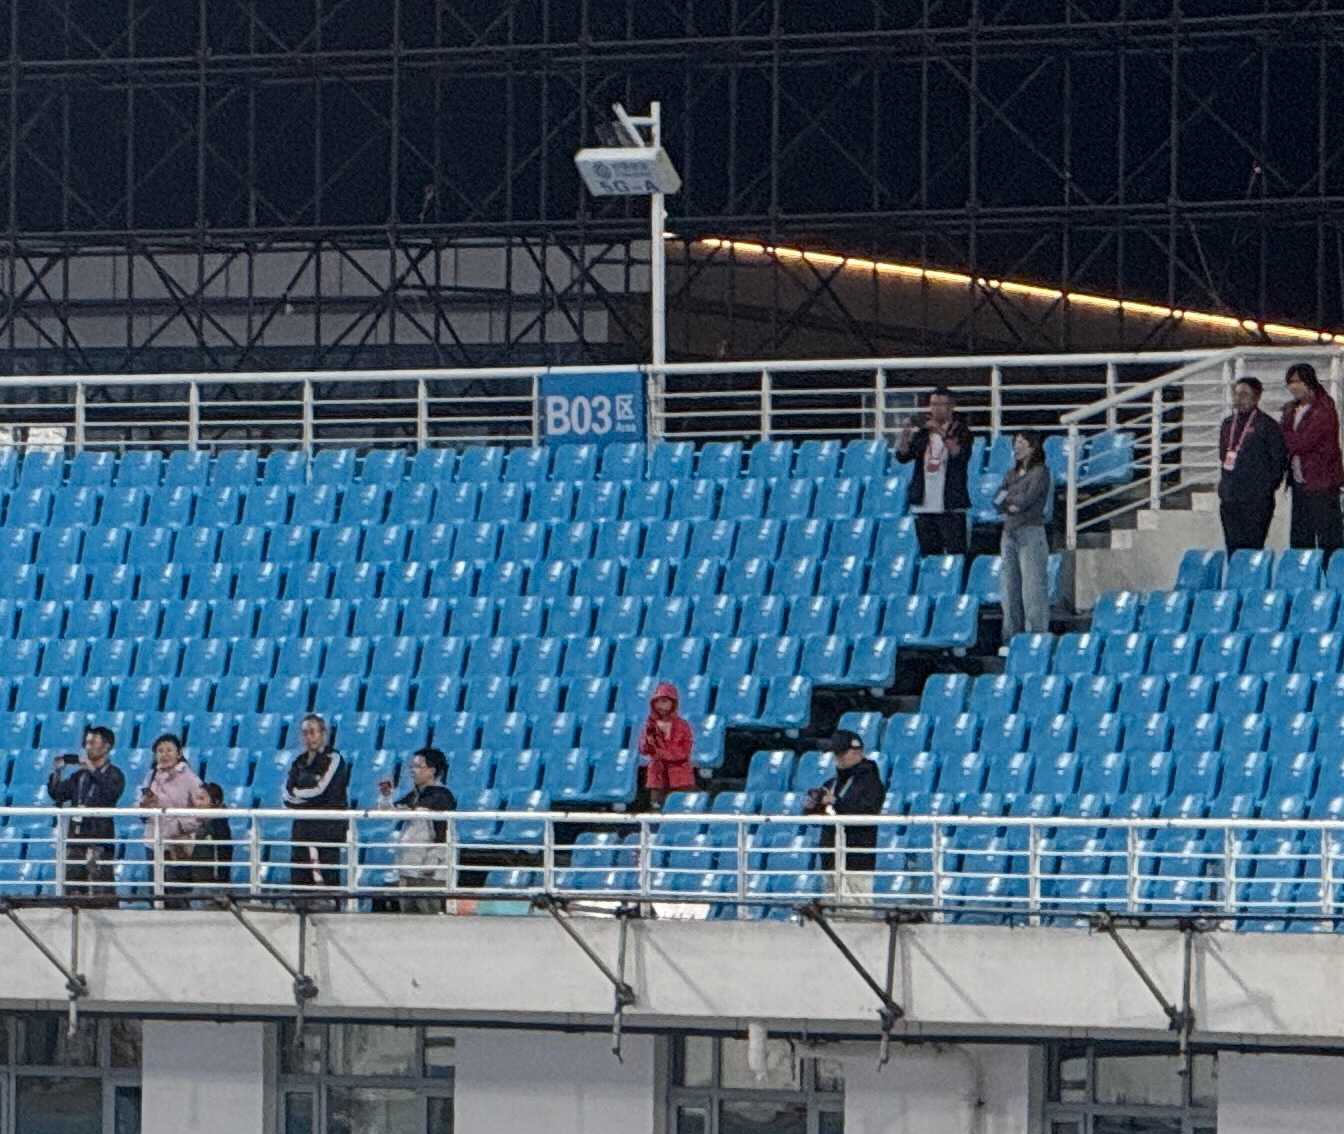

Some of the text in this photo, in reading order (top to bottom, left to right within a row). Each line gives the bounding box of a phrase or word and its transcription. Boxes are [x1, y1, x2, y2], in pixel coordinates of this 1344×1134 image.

[599, 179, 660, 193] 5G-A
[545, 394, 635, 435] B03 区
